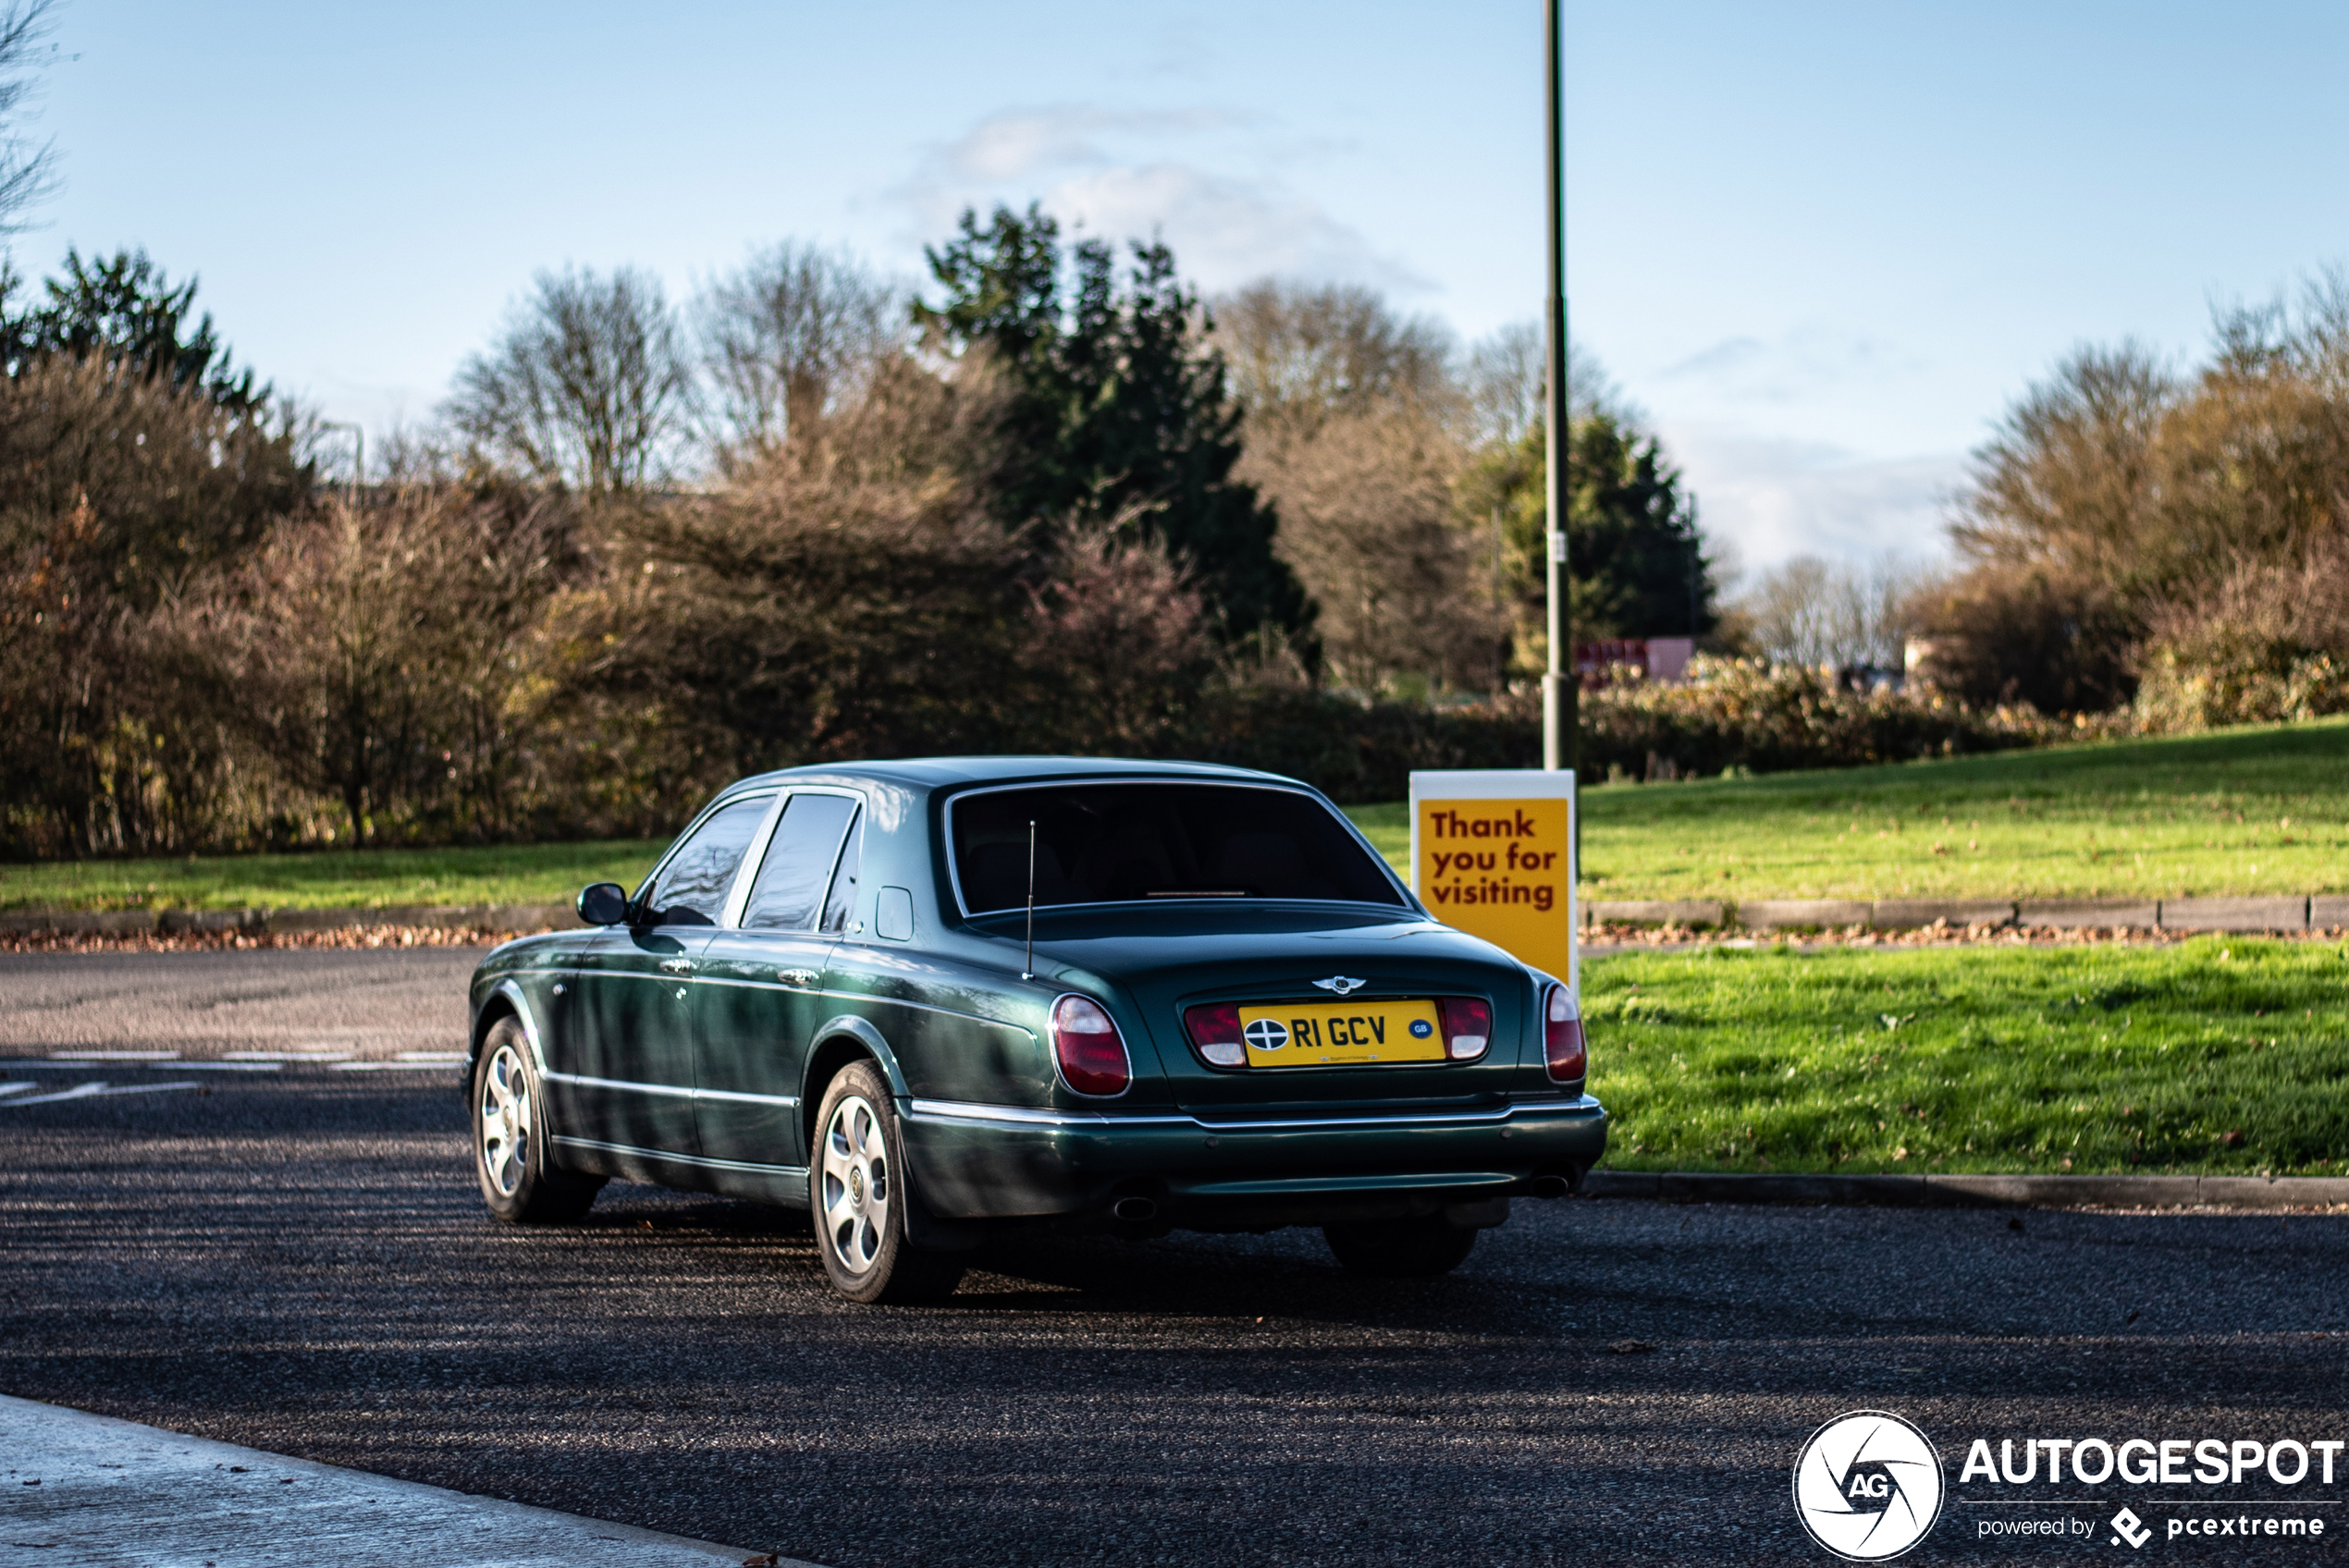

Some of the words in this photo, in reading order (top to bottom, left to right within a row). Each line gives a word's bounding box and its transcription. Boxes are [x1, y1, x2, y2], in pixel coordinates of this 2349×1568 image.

[1431, 809, 1535, 838] Thank
[1432, 851, 1495, 878] you
[1506, 842, 1556, 870] for
[1432, 877, 1554, 912] visiting
[1328, 1016, 1384, 1046] GCV
[1414, 1024, 1427, 1033] GB
